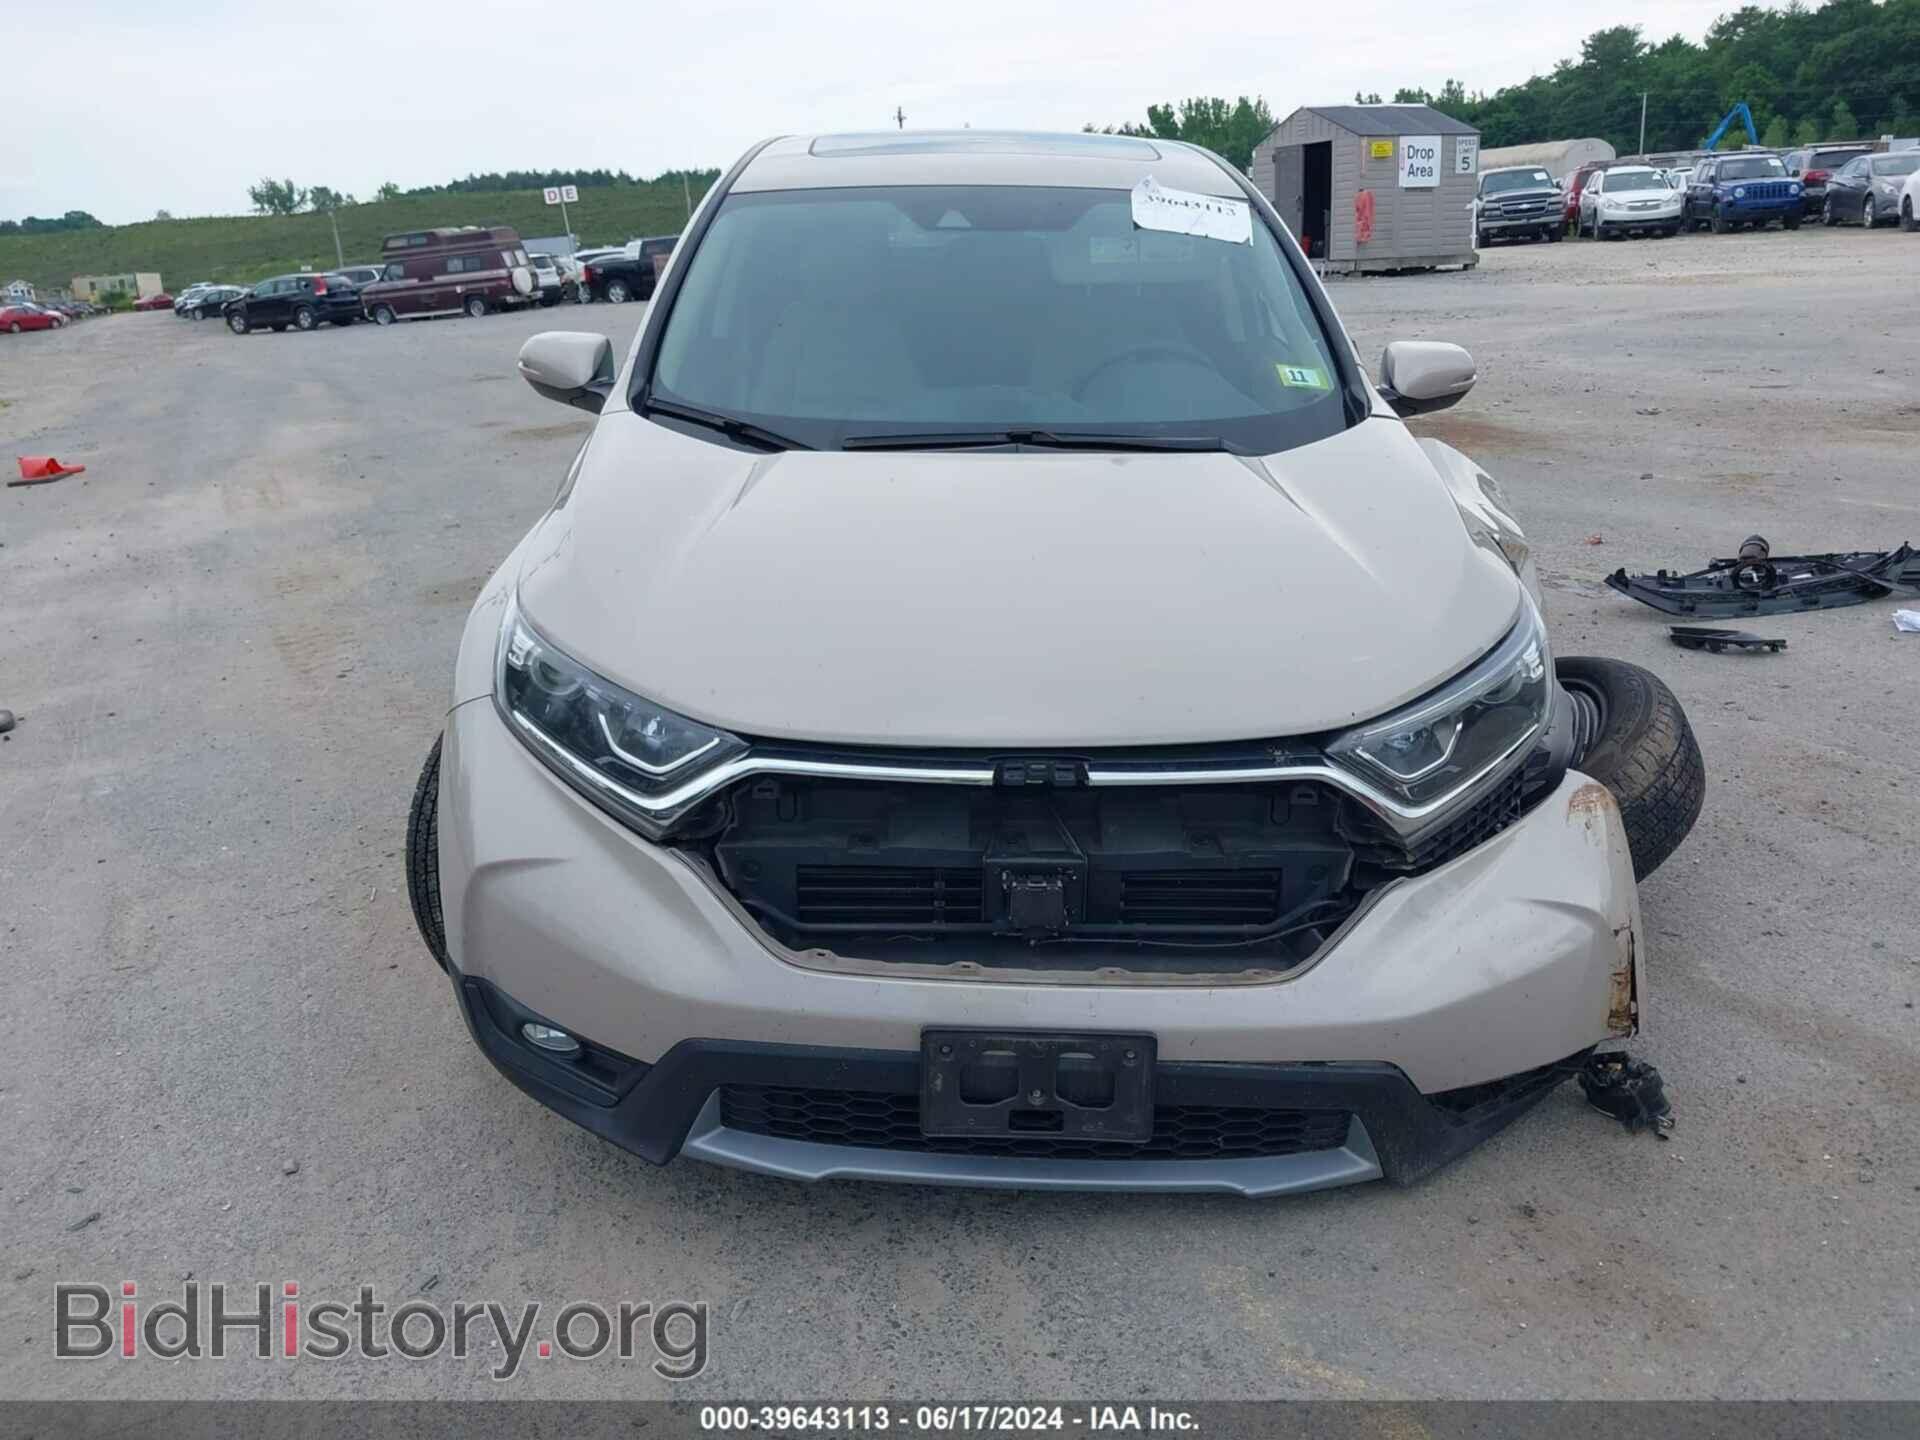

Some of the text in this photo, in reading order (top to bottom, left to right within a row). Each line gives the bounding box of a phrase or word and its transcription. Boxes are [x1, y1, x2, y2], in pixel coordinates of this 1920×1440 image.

[1457, 138, 1476, 146] SPEED
[1407, 144, 1434, 161] Drop
[1407, 163, 1433, 177] Area
[1462, 156, 1470, 171] 5
[547, 188, 575, 202] D E
[1288, 369, 1309, 383] 11
